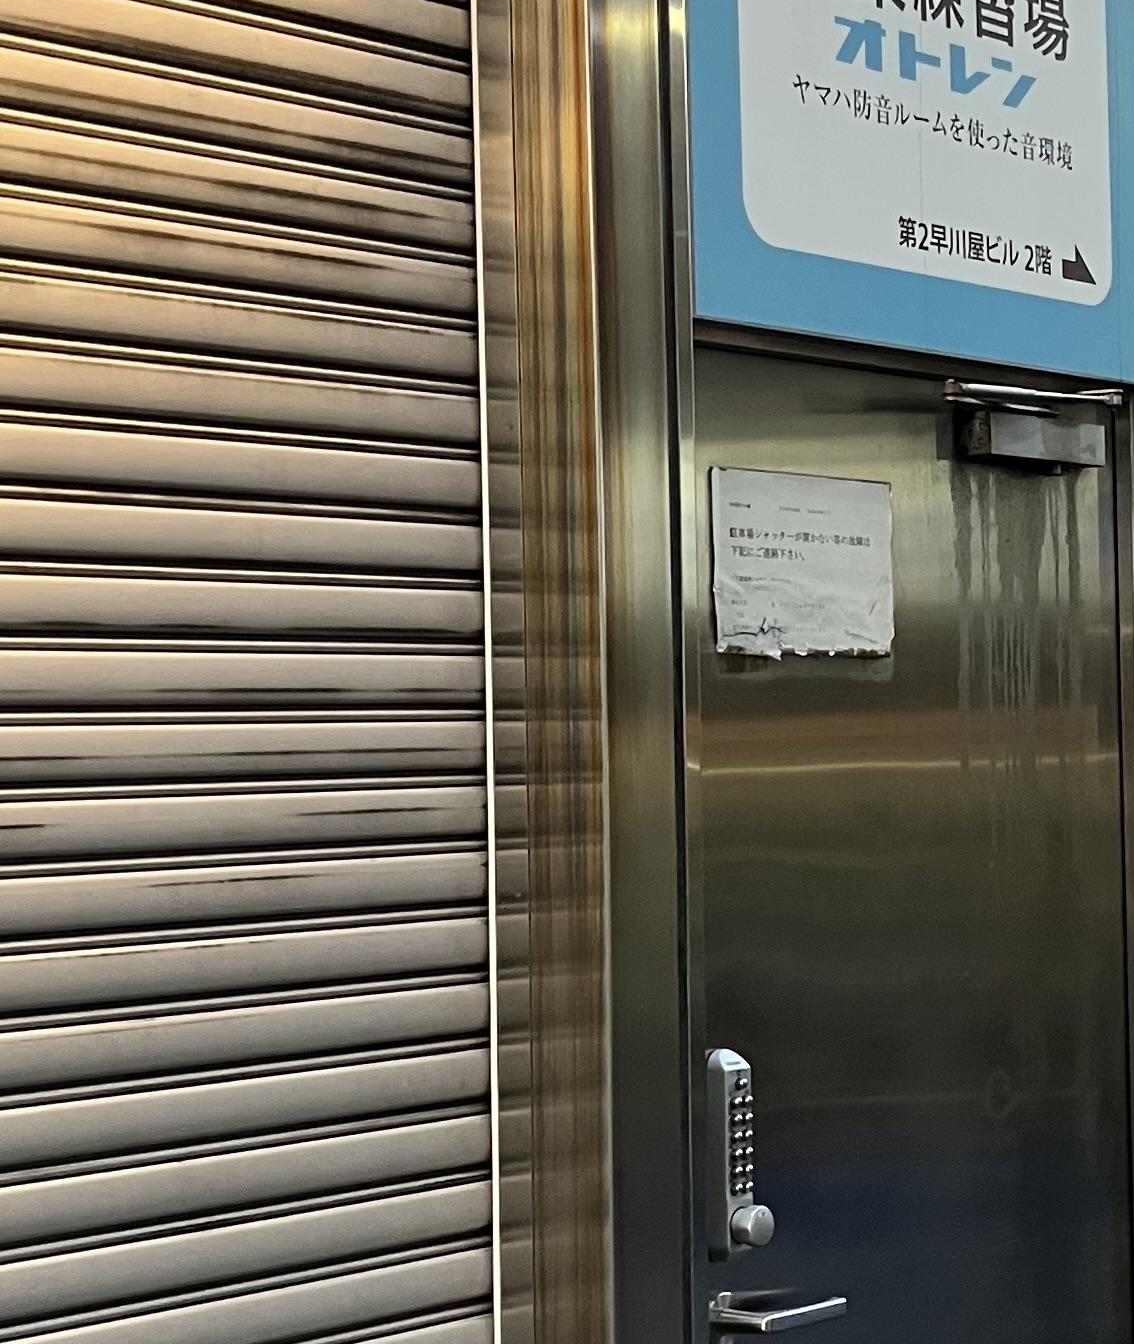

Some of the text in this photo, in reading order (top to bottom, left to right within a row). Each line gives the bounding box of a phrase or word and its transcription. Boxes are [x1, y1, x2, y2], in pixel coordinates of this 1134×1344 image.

[834, 15, 1037, 109] オトレン
[792, 74, 1073, 170] ヤマハ防音ルームを使った音環境
[898, 215, 1019, 266] 第2早川屋ビル
